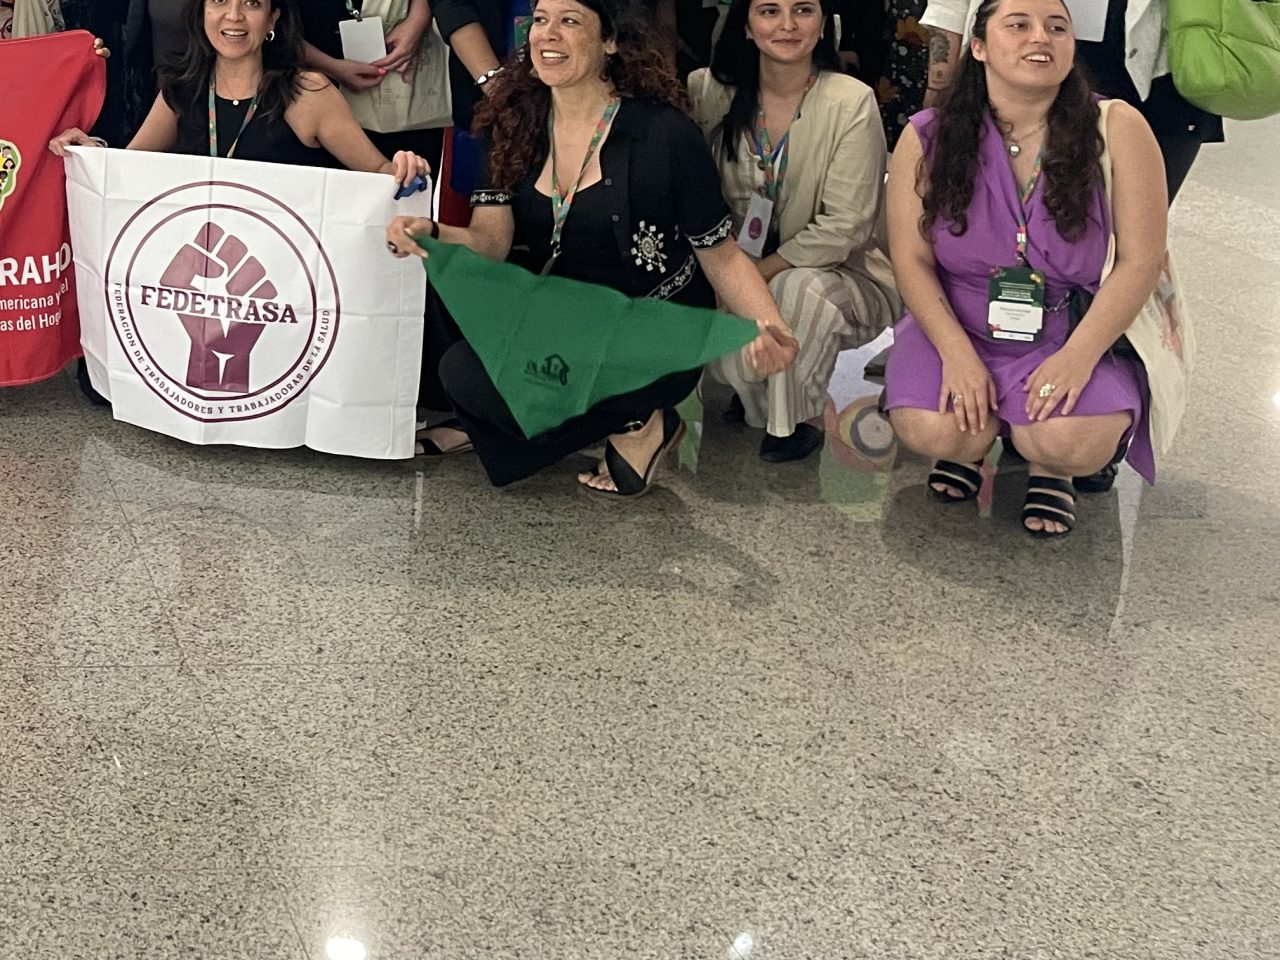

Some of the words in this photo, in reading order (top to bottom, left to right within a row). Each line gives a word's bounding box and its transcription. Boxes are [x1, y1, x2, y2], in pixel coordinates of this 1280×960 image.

[141, 284, 298, 324] FEDETRASA
[16, 314, 36, 331] del
[317, 309, 330, 344] SALUD
[133, 350, 145, 364] DE
[313, 345, 322, 358] LA
[302, 358, 313, 372] DE
[144, 365, 214, 415] TRABAJADORES
[228, 373, 304, 414] TRABAJADORAS
[217, 406, 225, 414] Y
